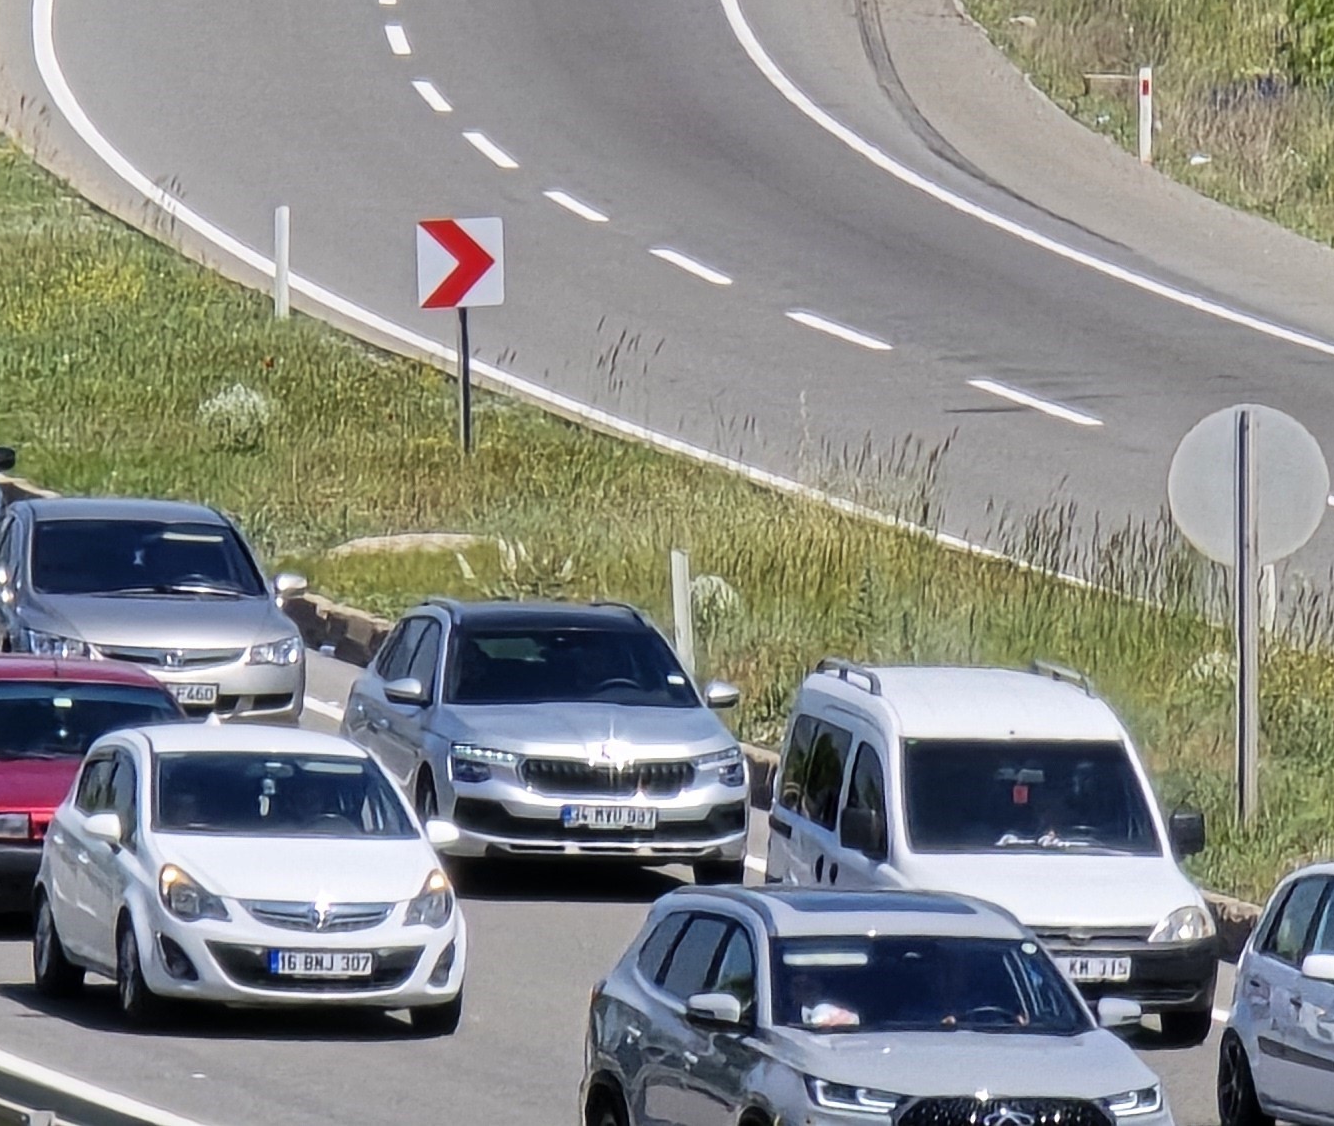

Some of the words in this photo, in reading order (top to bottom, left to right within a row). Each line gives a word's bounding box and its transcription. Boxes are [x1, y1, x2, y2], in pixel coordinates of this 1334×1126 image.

[281, 955, 297, 971] 16
[304, 955, 334, 971] BNJ
[341, 955, 370, 972] 307
